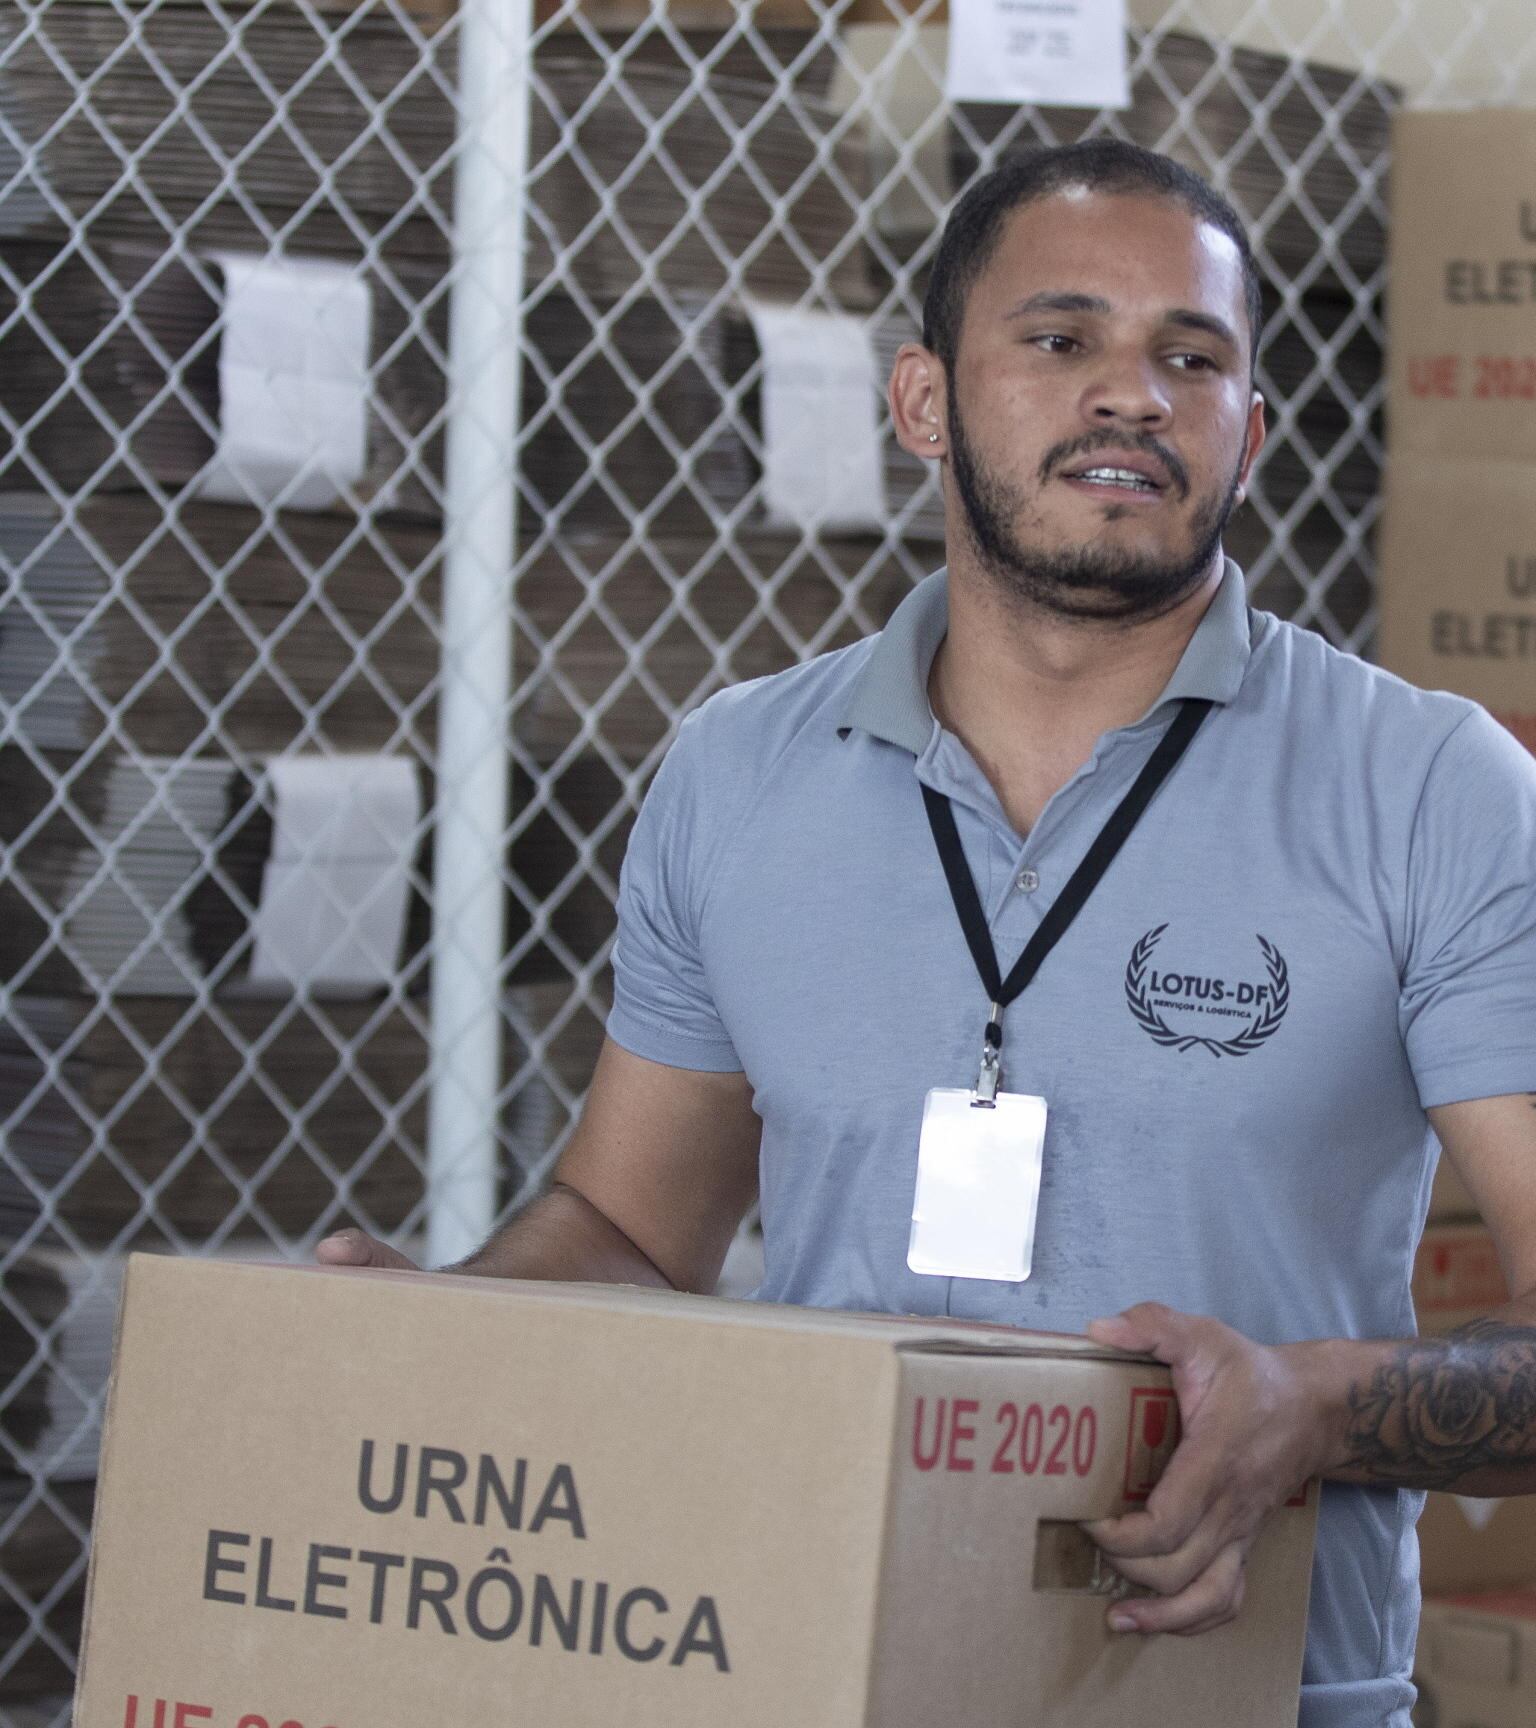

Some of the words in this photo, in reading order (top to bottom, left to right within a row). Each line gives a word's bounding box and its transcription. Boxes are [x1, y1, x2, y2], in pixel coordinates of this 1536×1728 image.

[1409, 356, 1457, 399] UE
[1150, 971, 1268, 1006] LOTUS-DF
[1153, 999, 1195, 1012] SERVIÇOS
[1197, 1005, 1204, 1013] &
[913, 1399, 980, 1472] UE
[991, 1401, 1097, 1476] 2020
[358, 1439, 586, 1539] URNA
[202, 1528, 731, 1673] ELETRÔNICA
